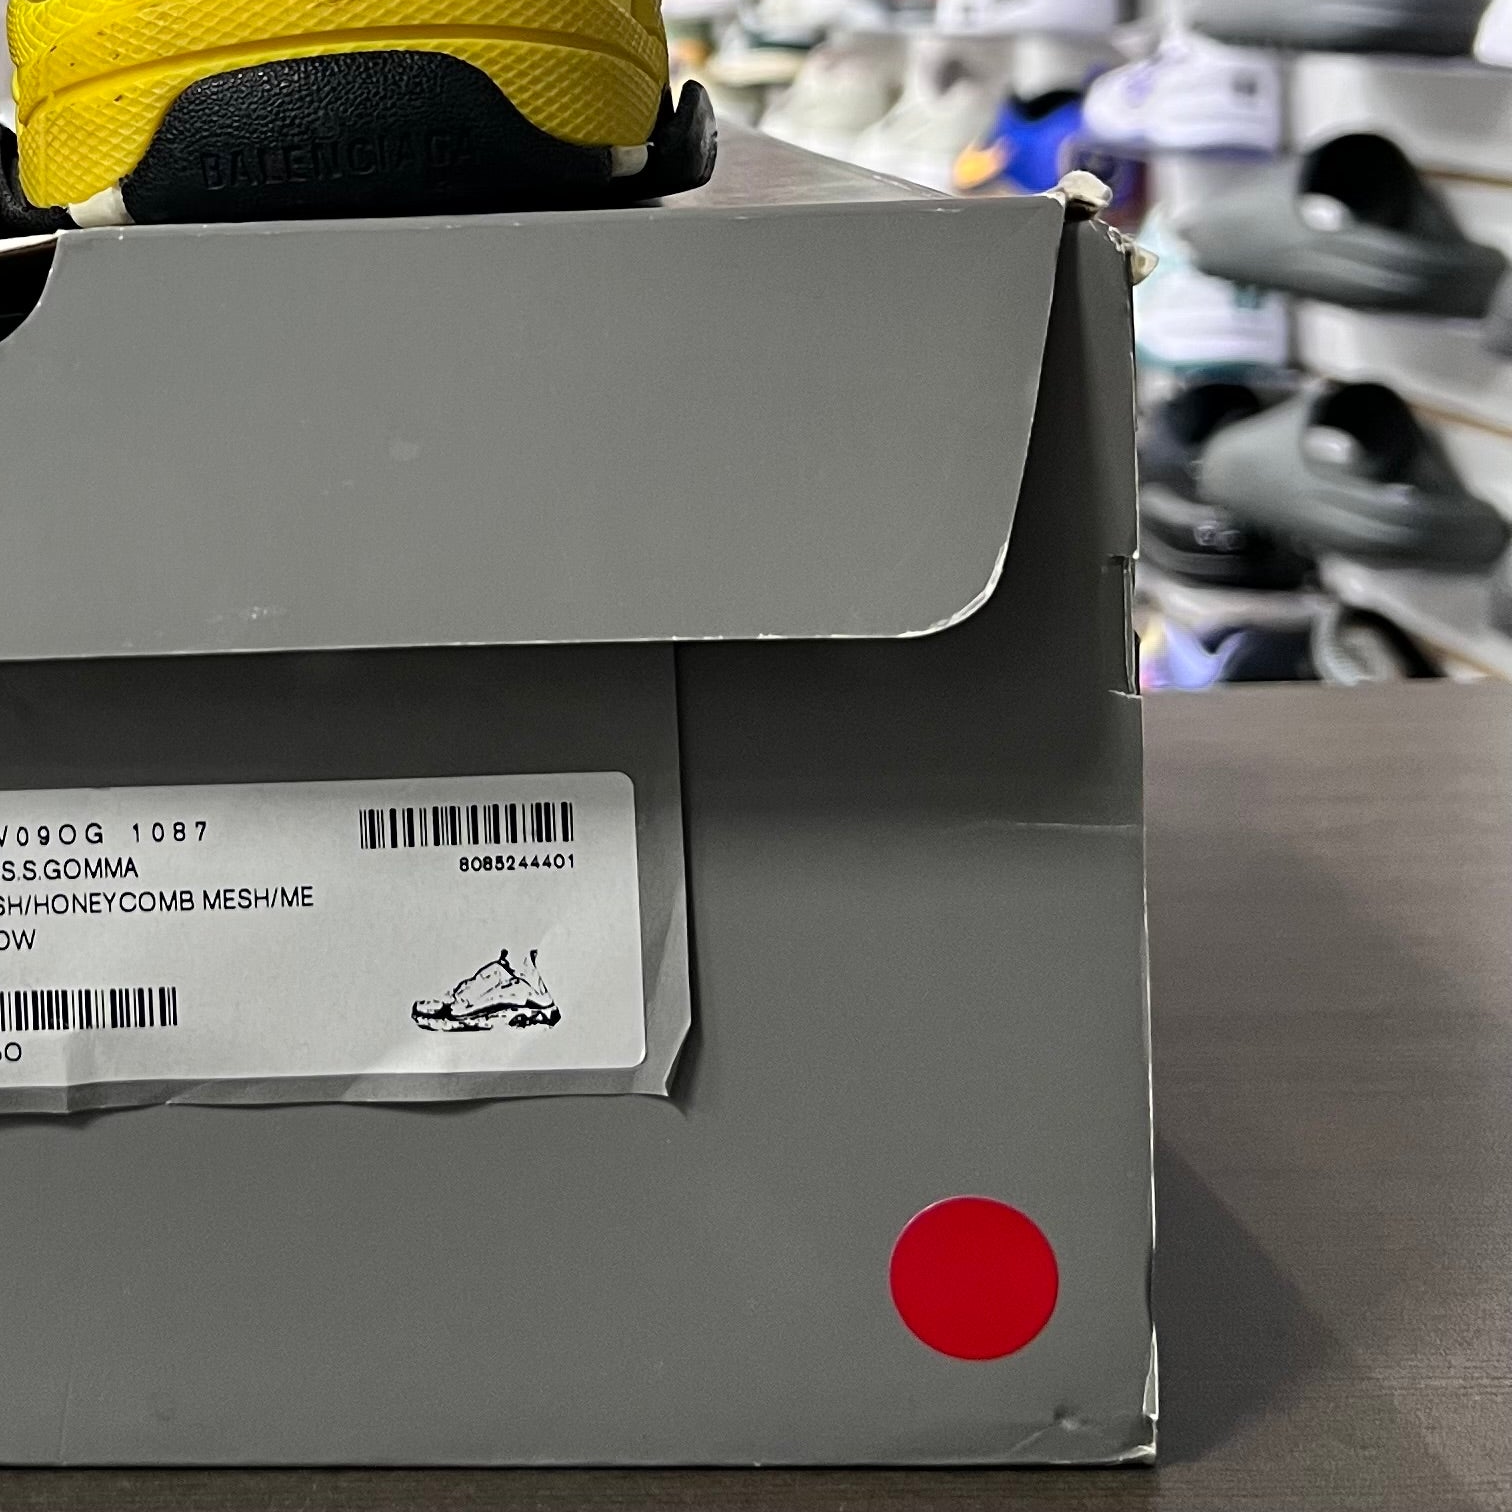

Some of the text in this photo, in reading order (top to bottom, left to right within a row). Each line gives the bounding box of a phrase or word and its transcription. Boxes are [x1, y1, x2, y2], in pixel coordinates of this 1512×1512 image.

[132, 820, 207, 843] 1087
[458, 853, 575, 872] 8085244401
[202, 885, 315, 910] MESH/ME
